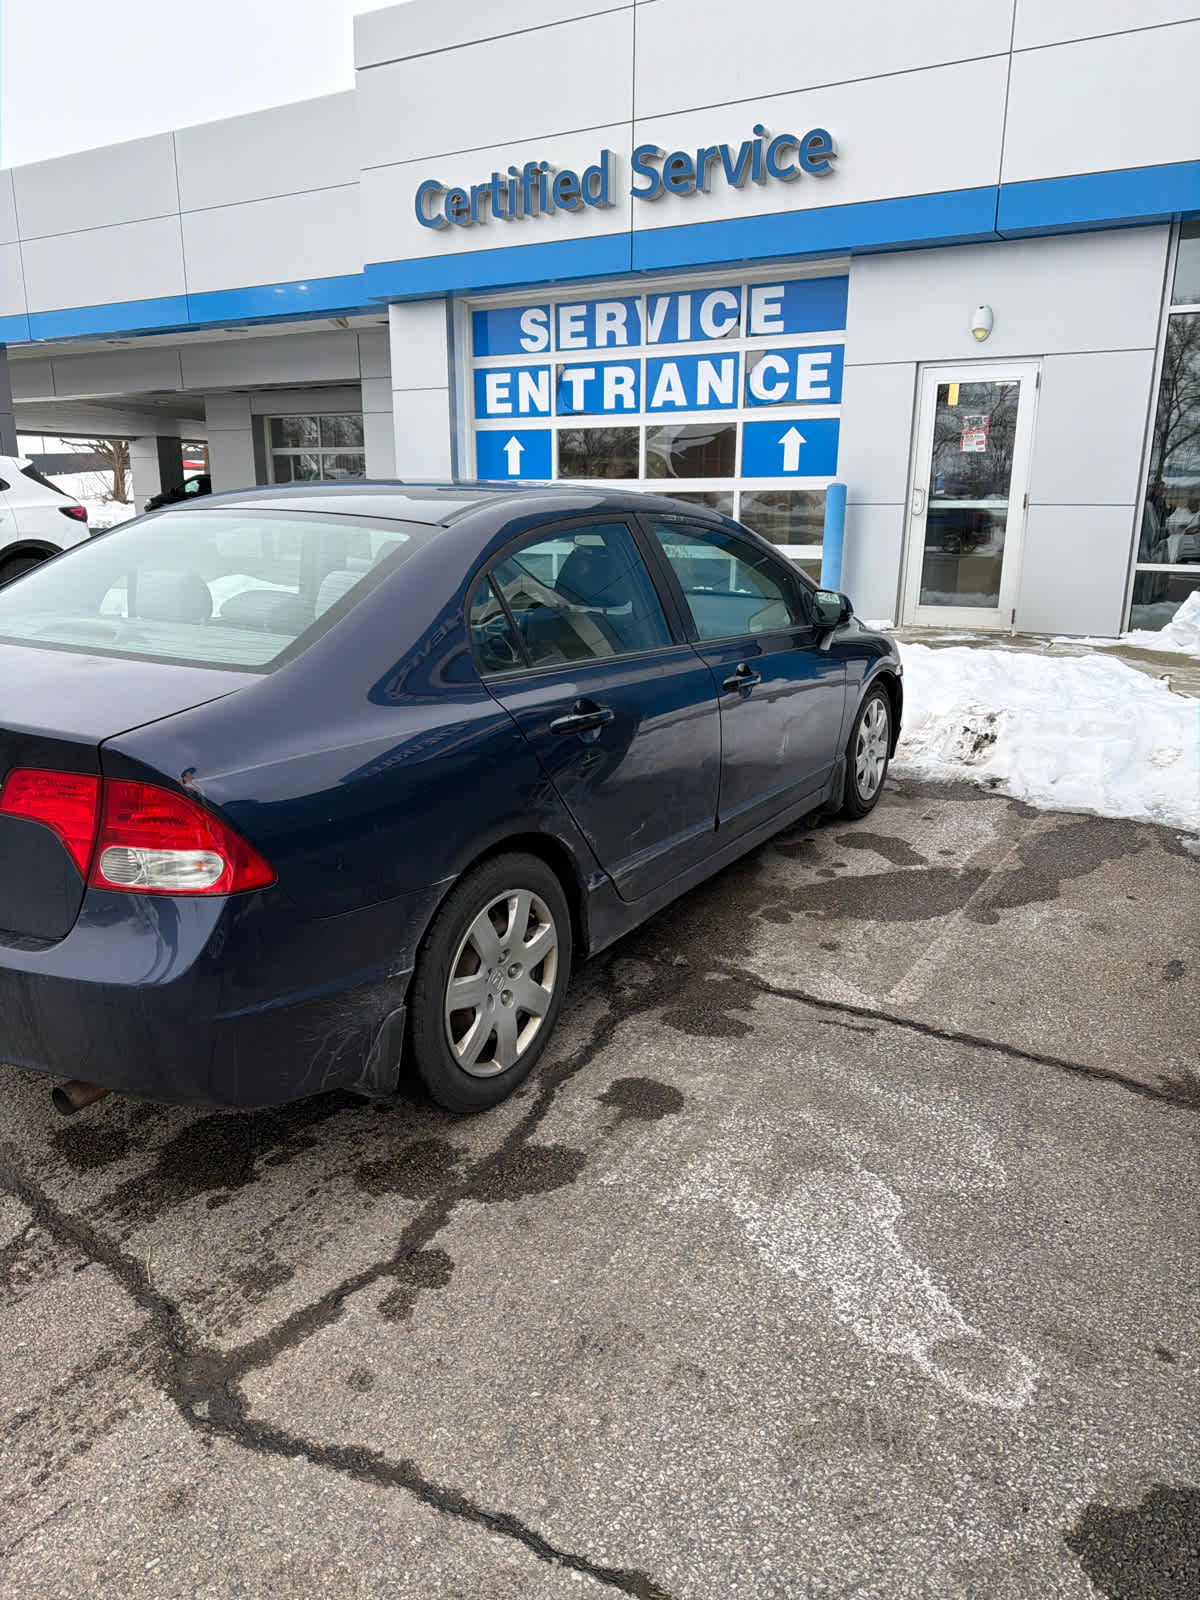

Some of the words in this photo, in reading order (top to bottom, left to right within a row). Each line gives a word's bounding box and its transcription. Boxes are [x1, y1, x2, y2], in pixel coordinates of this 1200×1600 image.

[414, 150, 616, 229] Certified
[630, 124, 837, 200] Service
[519, 285, 785, 352] SERVICE
[485, 352, 832, 414] ENTRANCE
